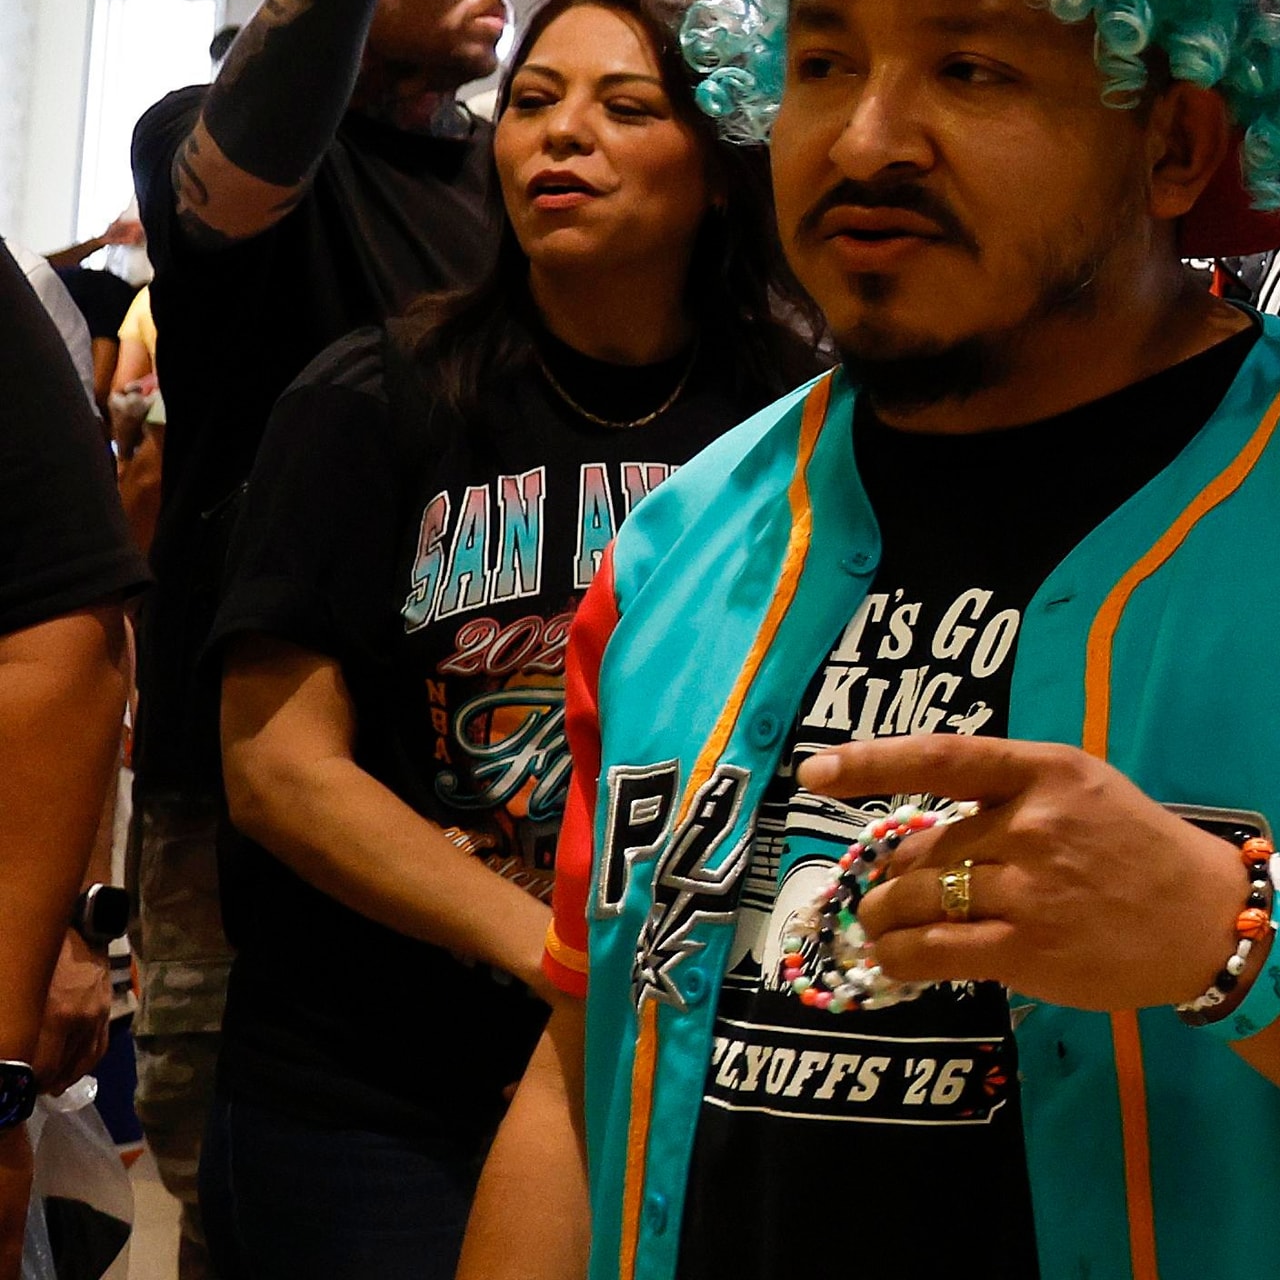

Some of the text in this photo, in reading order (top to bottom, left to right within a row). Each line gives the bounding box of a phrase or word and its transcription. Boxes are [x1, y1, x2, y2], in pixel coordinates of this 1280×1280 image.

[401, 466, 546, 634] SAN
[437, 615, 573, 676] 202
[931, 587, 1021, 679] GO
